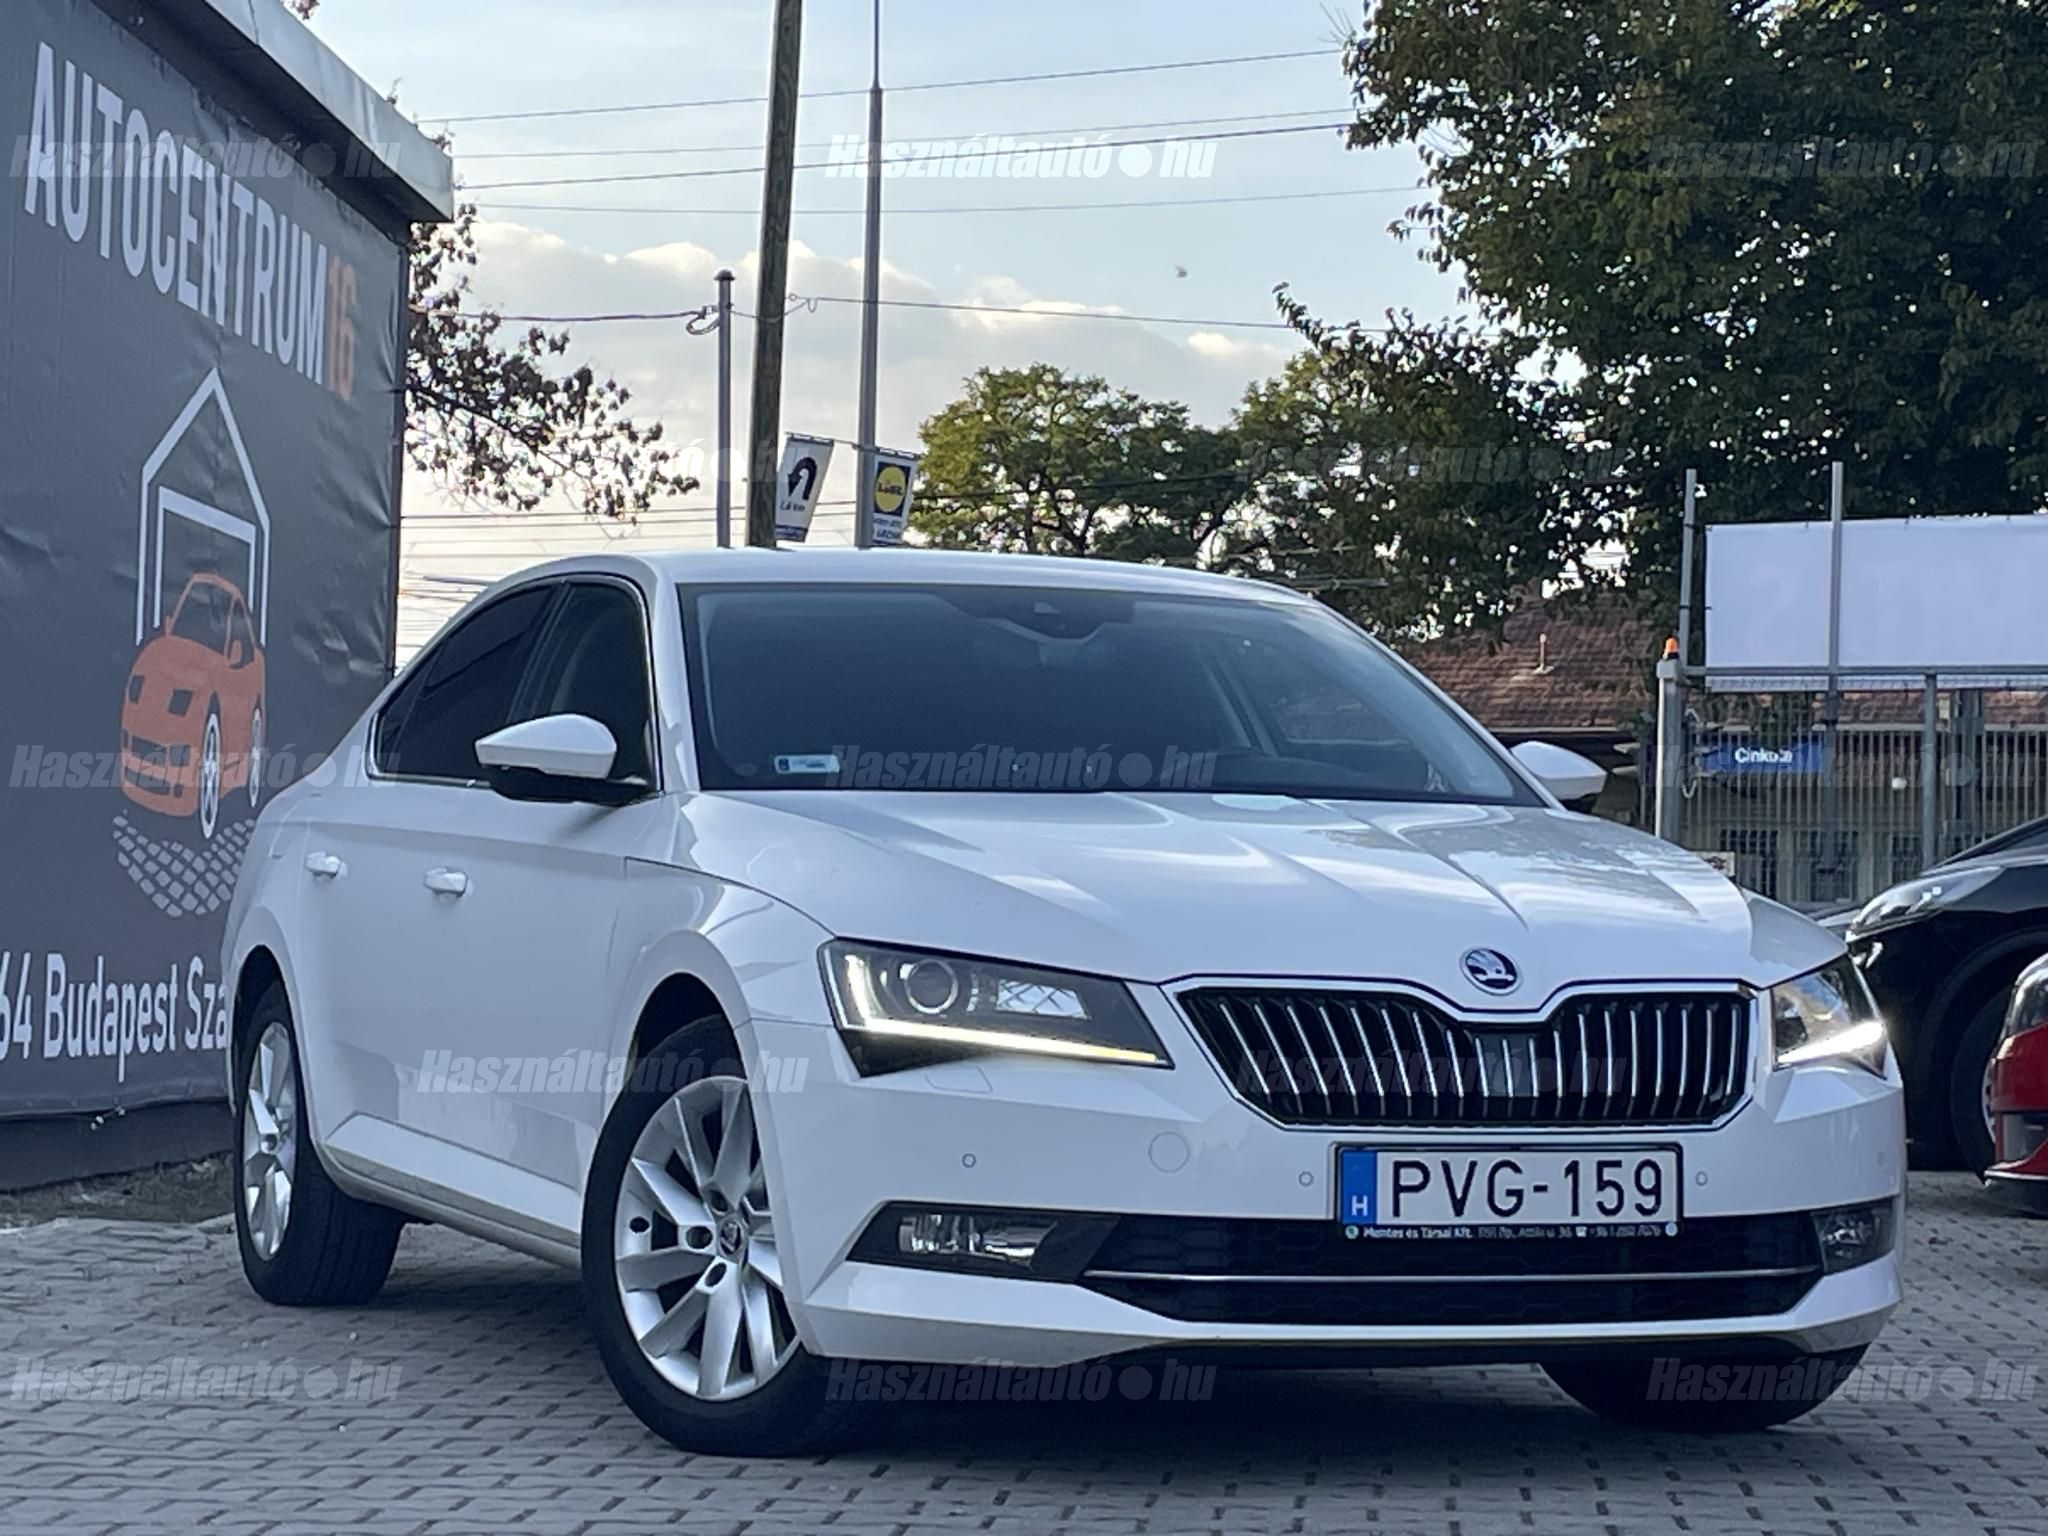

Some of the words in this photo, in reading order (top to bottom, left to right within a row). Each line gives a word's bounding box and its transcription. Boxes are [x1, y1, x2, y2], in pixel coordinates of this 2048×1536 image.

[44, 953, 178, 1083] Budapest
[1351, 1195, 1368, 1217] H
[1392, 1159, 1662, 1218] PVG-159
